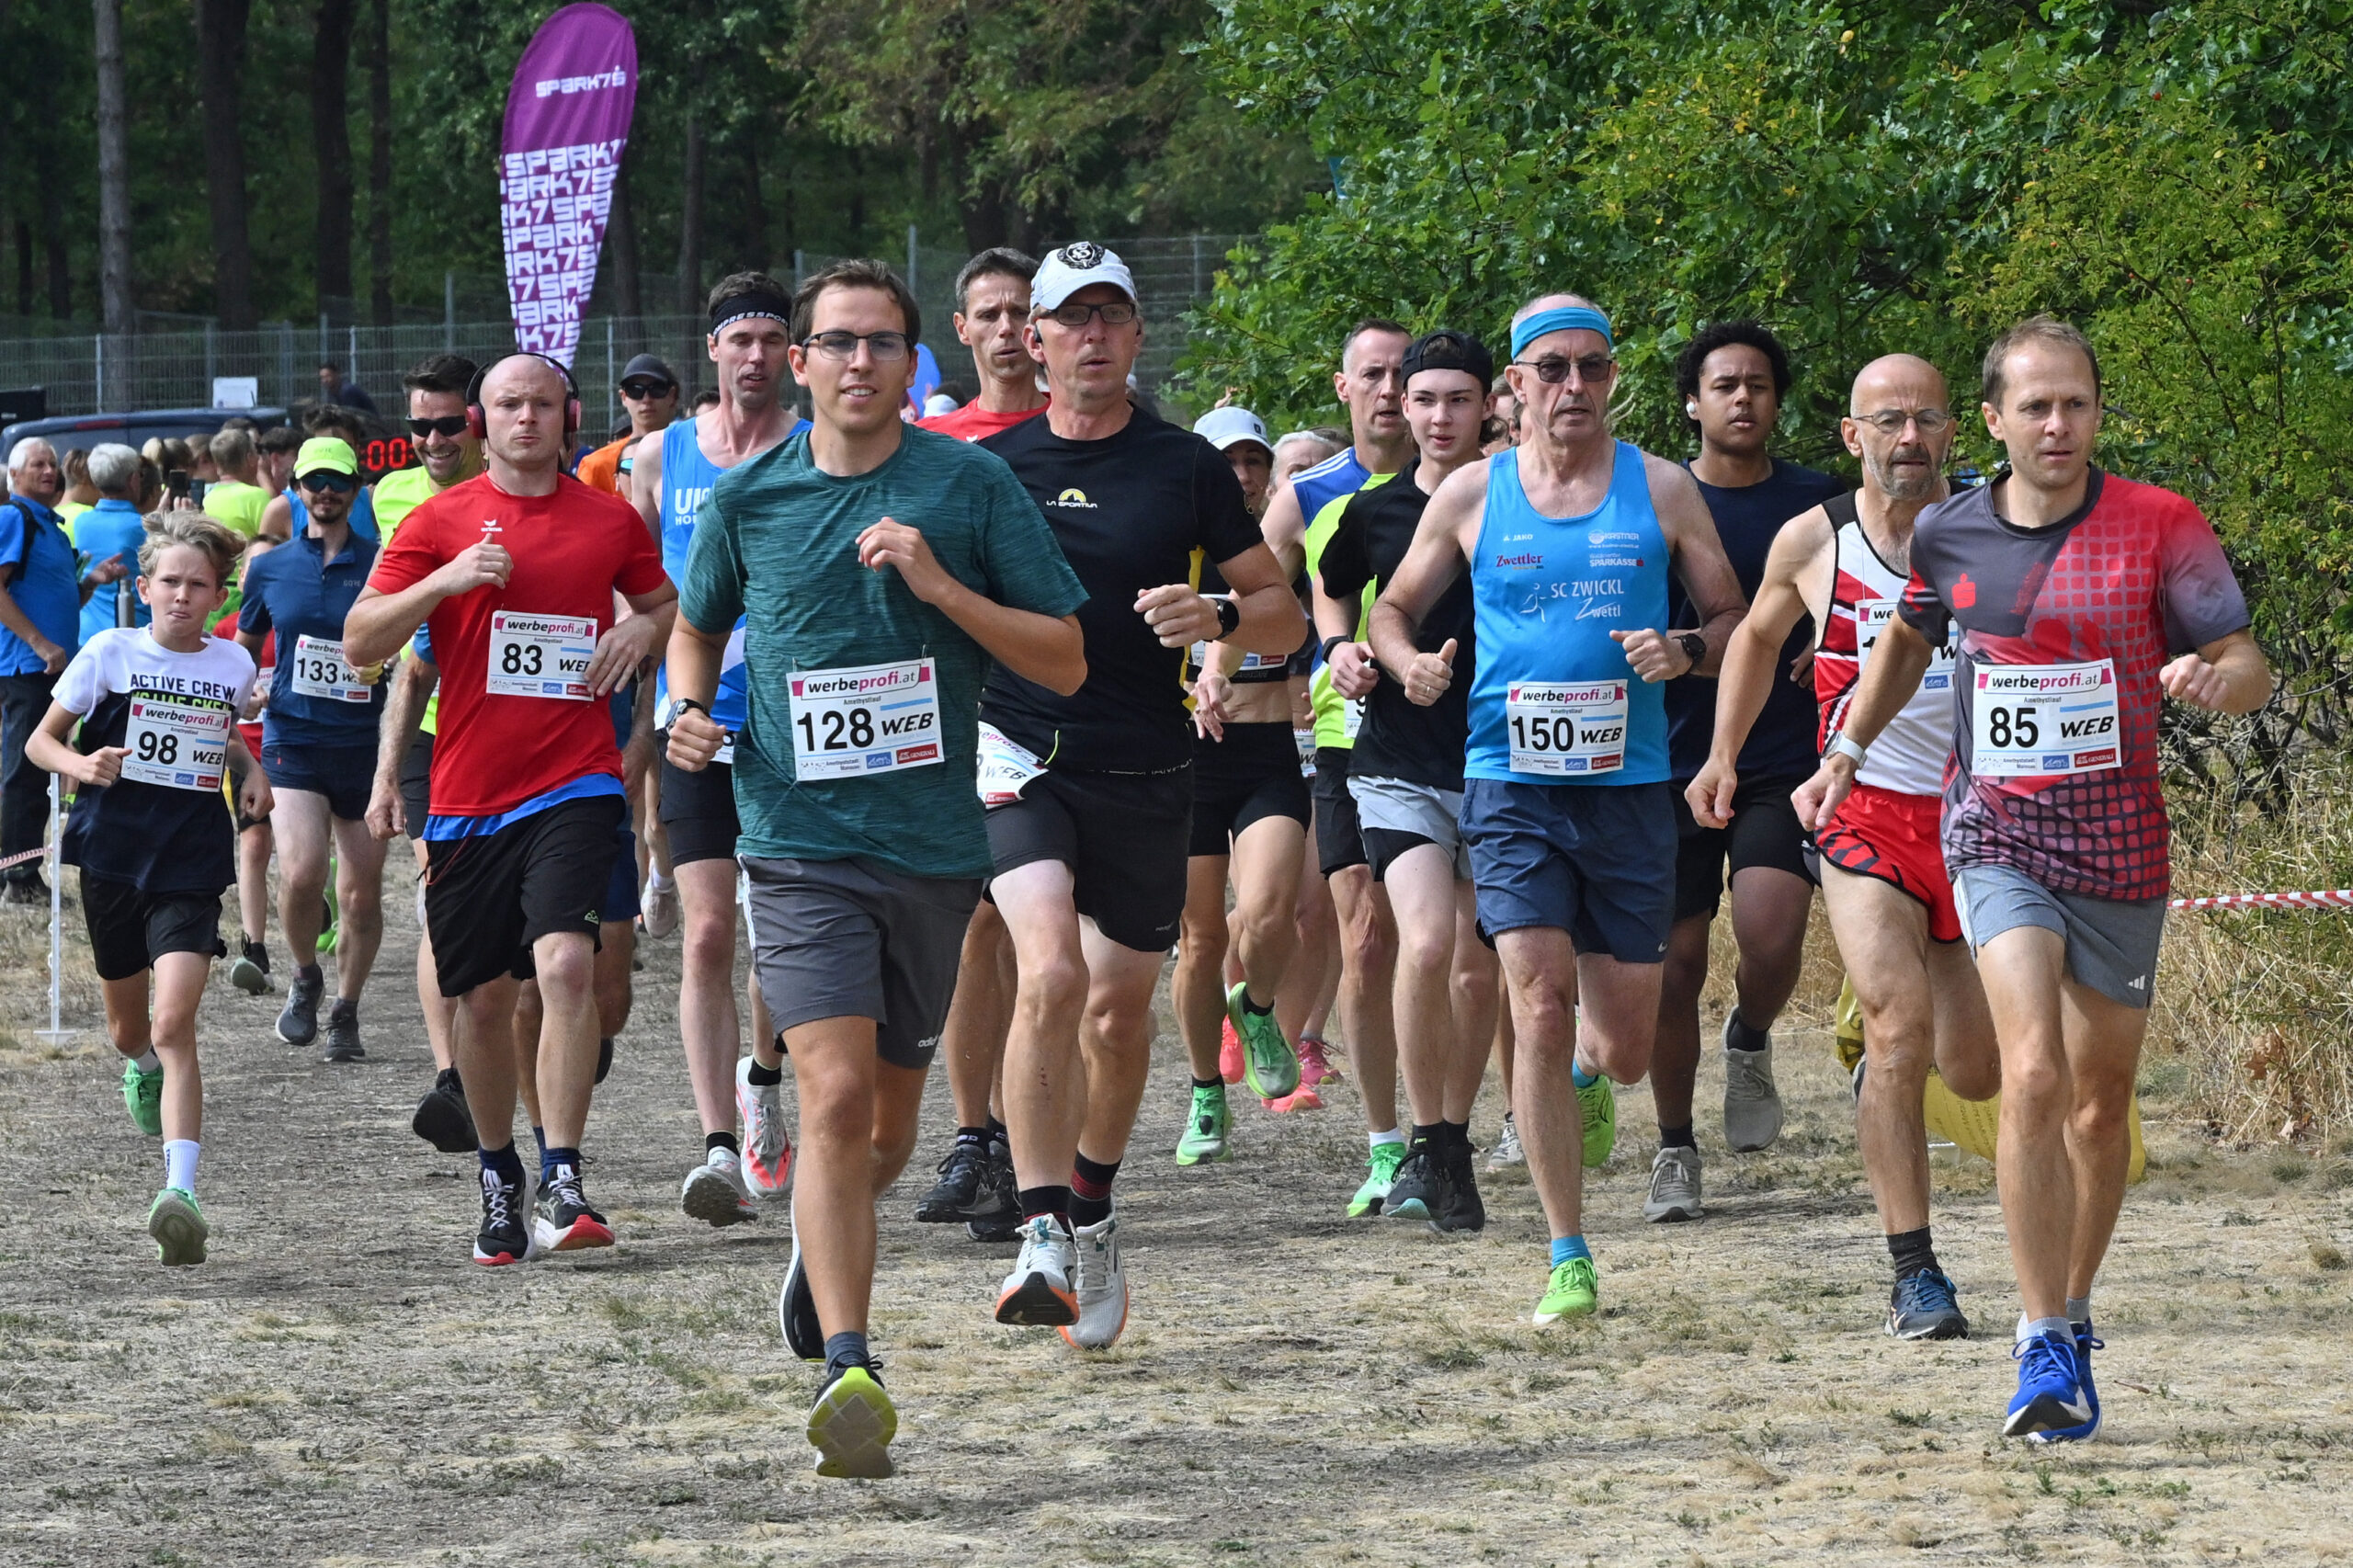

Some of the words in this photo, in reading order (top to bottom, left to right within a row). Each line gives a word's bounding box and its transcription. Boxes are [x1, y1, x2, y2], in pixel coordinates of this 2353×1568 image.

[1513, 533, 1533, 541] JAKO
[1495, 552, 1544, 568] Zwettler
[1589, 557, 1637, 567] SPARKASSE
[1551, 583, 1567, 598] SC
[1572, 579, 1624, 597] ZWICKL
[1574, 597, 1621, 620] Zwettl
[507, 620, 584, 634] werbeprofi.at
[502, 642, 543, 676] 83
[297, 657, 338, 684] 133
[131, 674, 186, 693] ACTIVE
[191, 680, 236, 701] CREW
[808, 671, 915, 693] werbeprofi.at
[1992, 673, 2097, 691] werbeprofi.at
[1523, 688, 1612, 704] werbeprofi.at
[145, 708, 222, 726] werbeprofi.at
[1990, 707, 2039, 748] 85
[2060, 716, 2115, 738] W.E.B
[797, 708, 875, 752] 128
[881, 712, 934, 736] W.E.B
[1511, 716, 1574, 752] 150
[137, 731, 178, 765] 98
